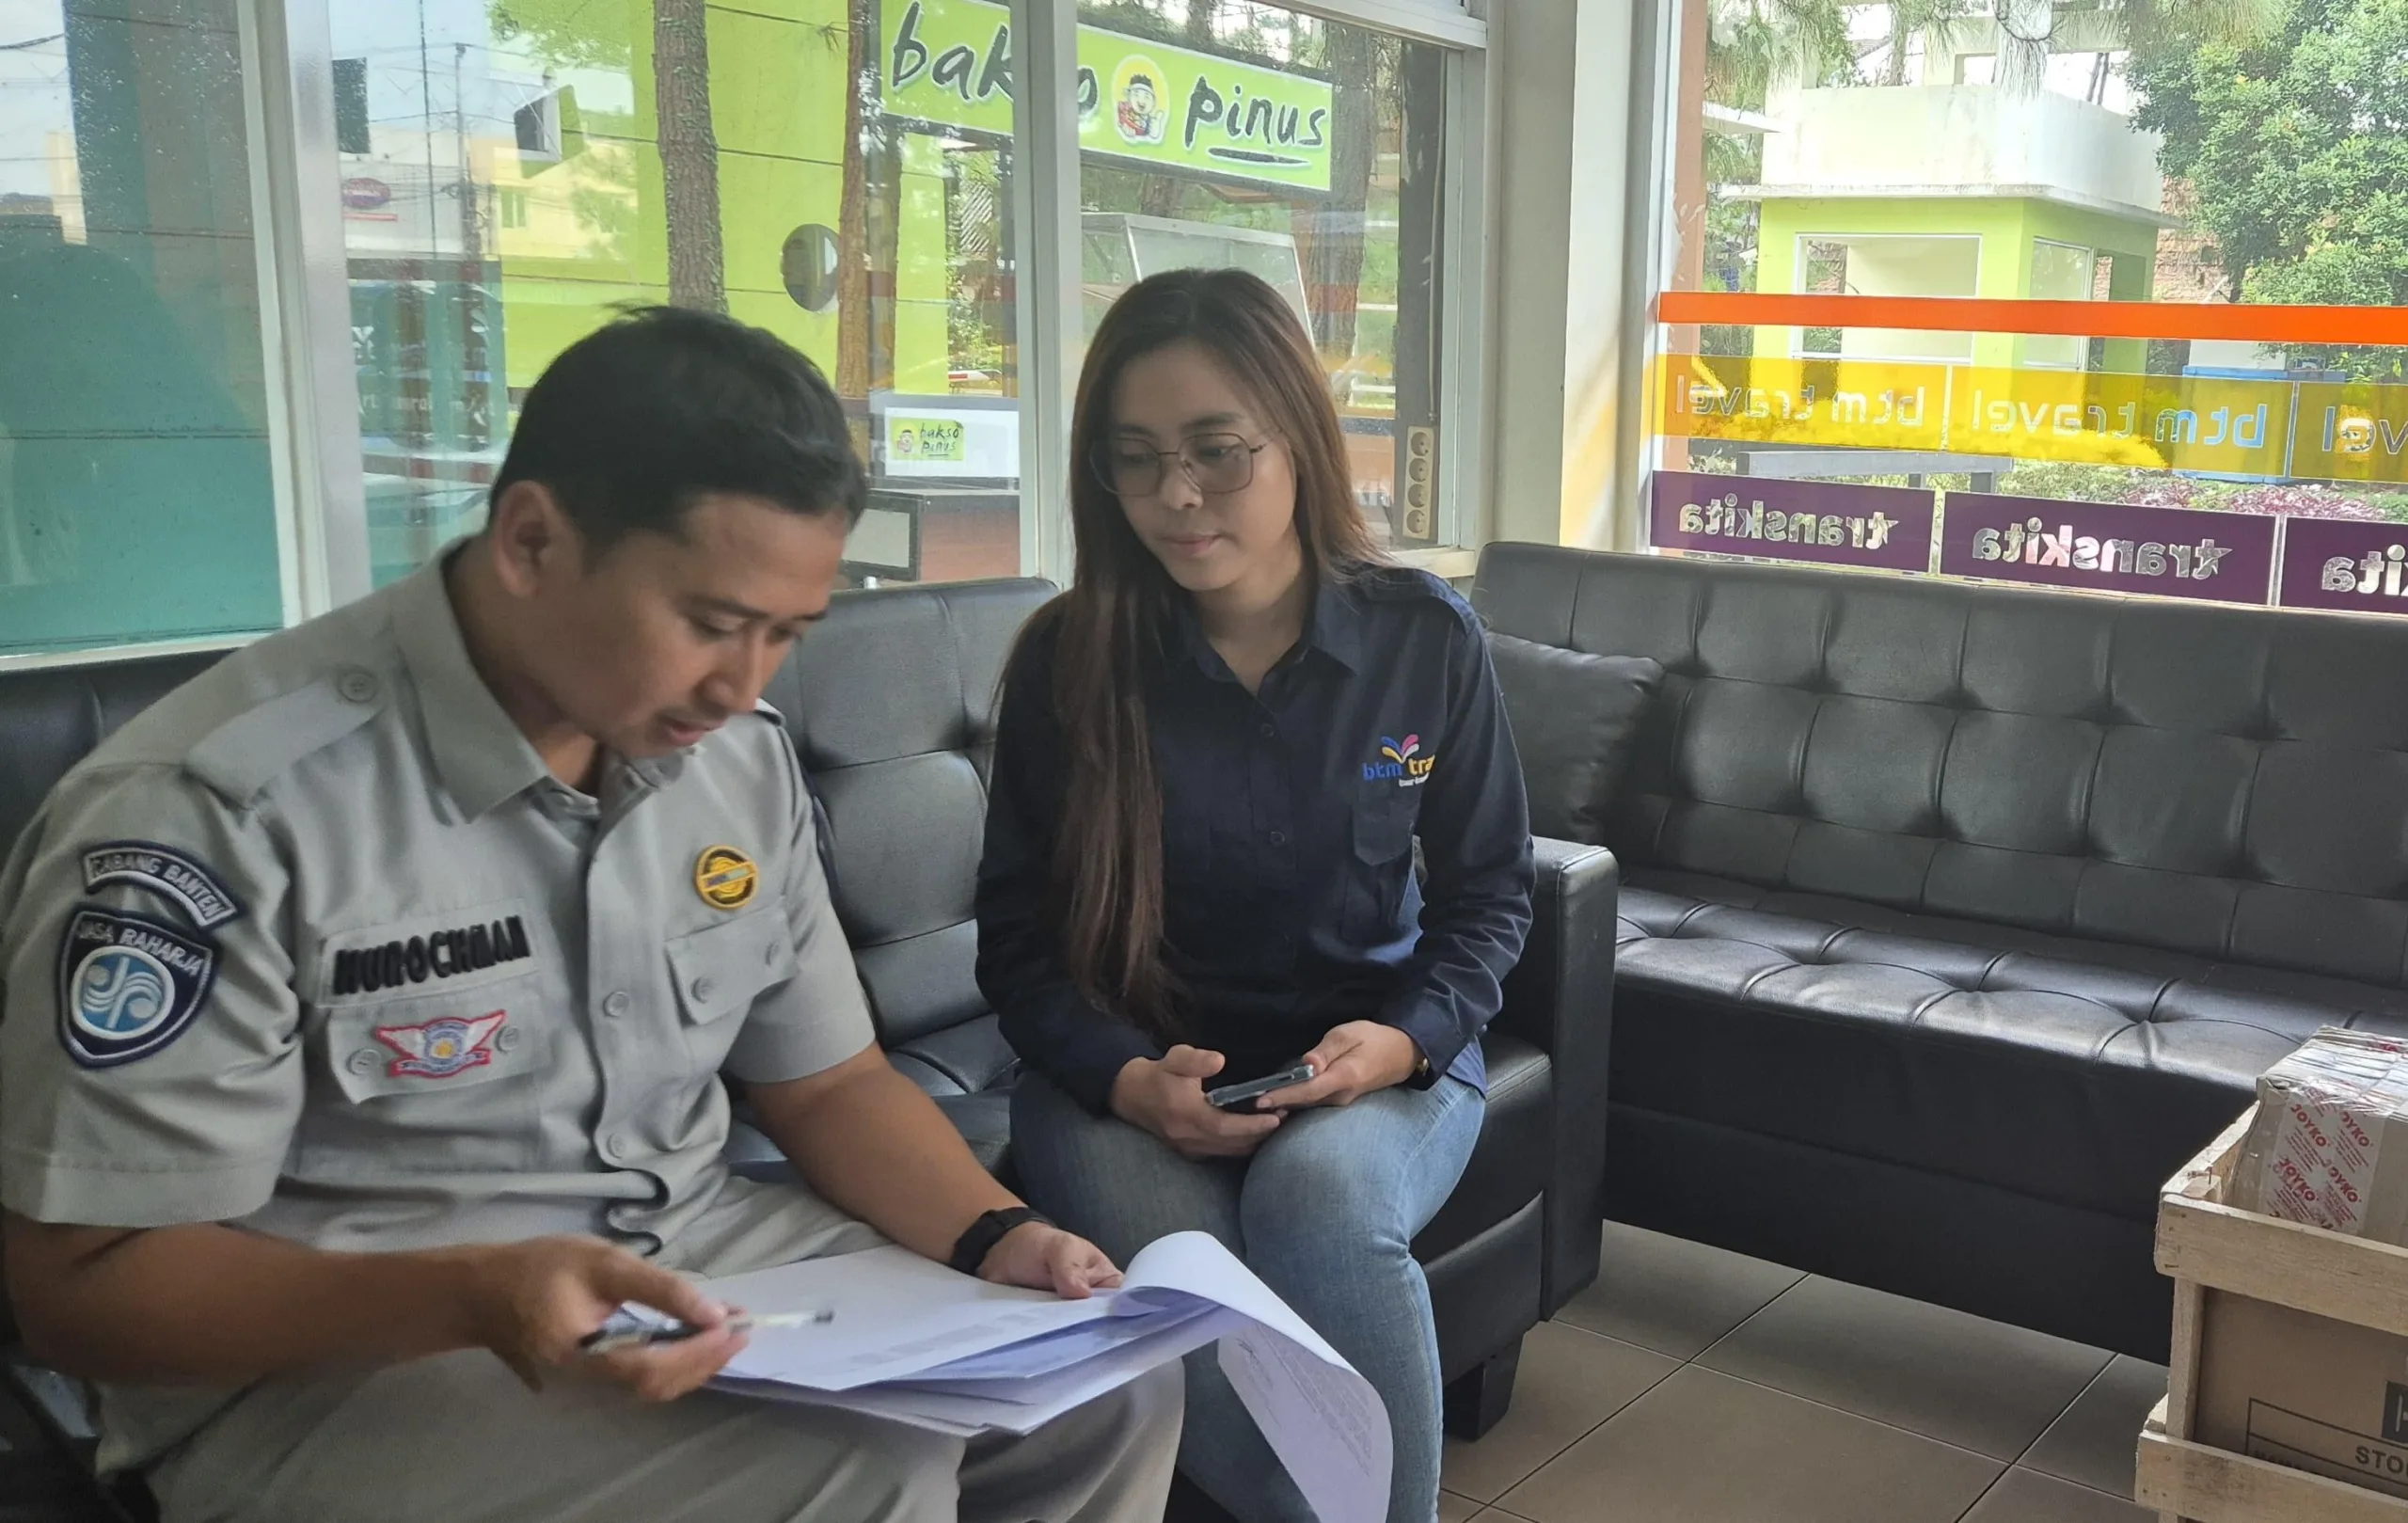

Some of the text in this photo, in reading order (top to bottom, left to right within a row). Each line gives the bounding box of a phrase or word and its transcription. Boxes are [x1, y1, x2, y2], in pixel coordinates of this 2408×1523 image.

[893, 1, 1325, 148] bako pinus
[920, 421, 959, 438] bakso
[922, 440, 956, 453] pinus
[1362, 761, 1403, 781] btm
[93, 854, 225, 918] CABANG BANTEN
[118, 928, 205, 977] RAHARJA
[2290, 1103, 2327, 1147] JOYKO
[2339, 1110, 2370, 1147] OYKO
[2354, 1445, 2408, 1474] STO
